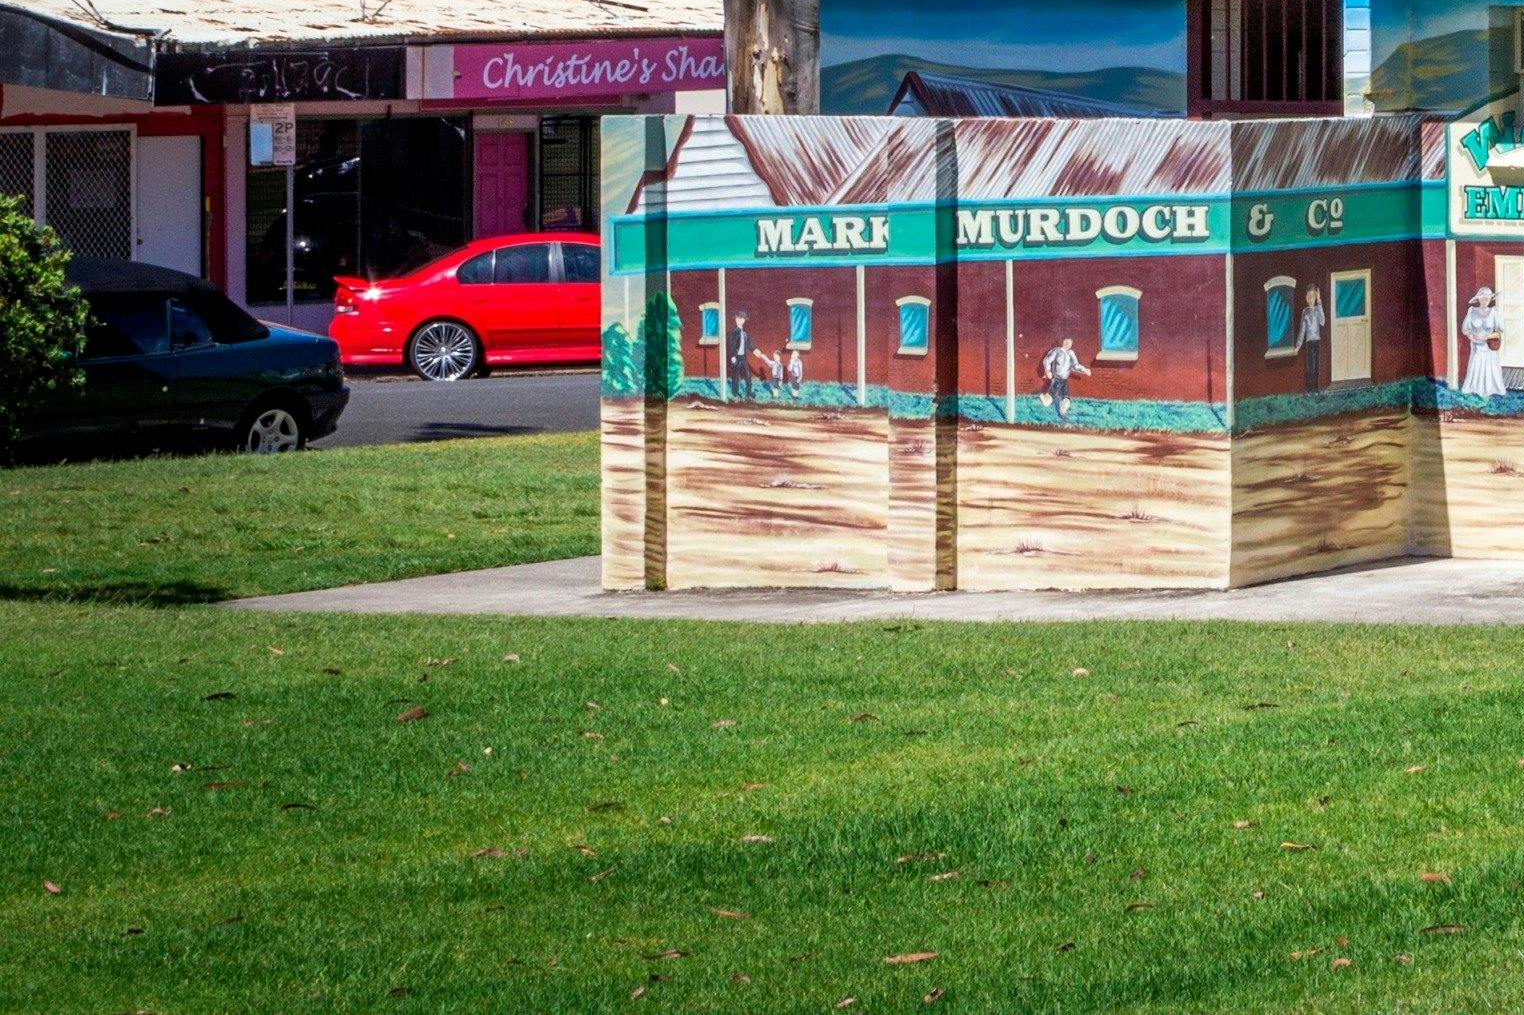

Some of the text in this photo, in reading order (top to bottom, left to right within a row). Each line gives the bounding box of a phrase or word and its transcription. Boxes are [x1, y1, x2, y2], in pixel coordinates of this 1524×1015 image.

[483, 46, 726, 90] Christine's Sha
[274, 122, 294, 134] 2P
[757, 215, 889, 253] MARK
[957, 204, 1210, 245] MURDOCH
[1248, 203, 1274, 237] &
